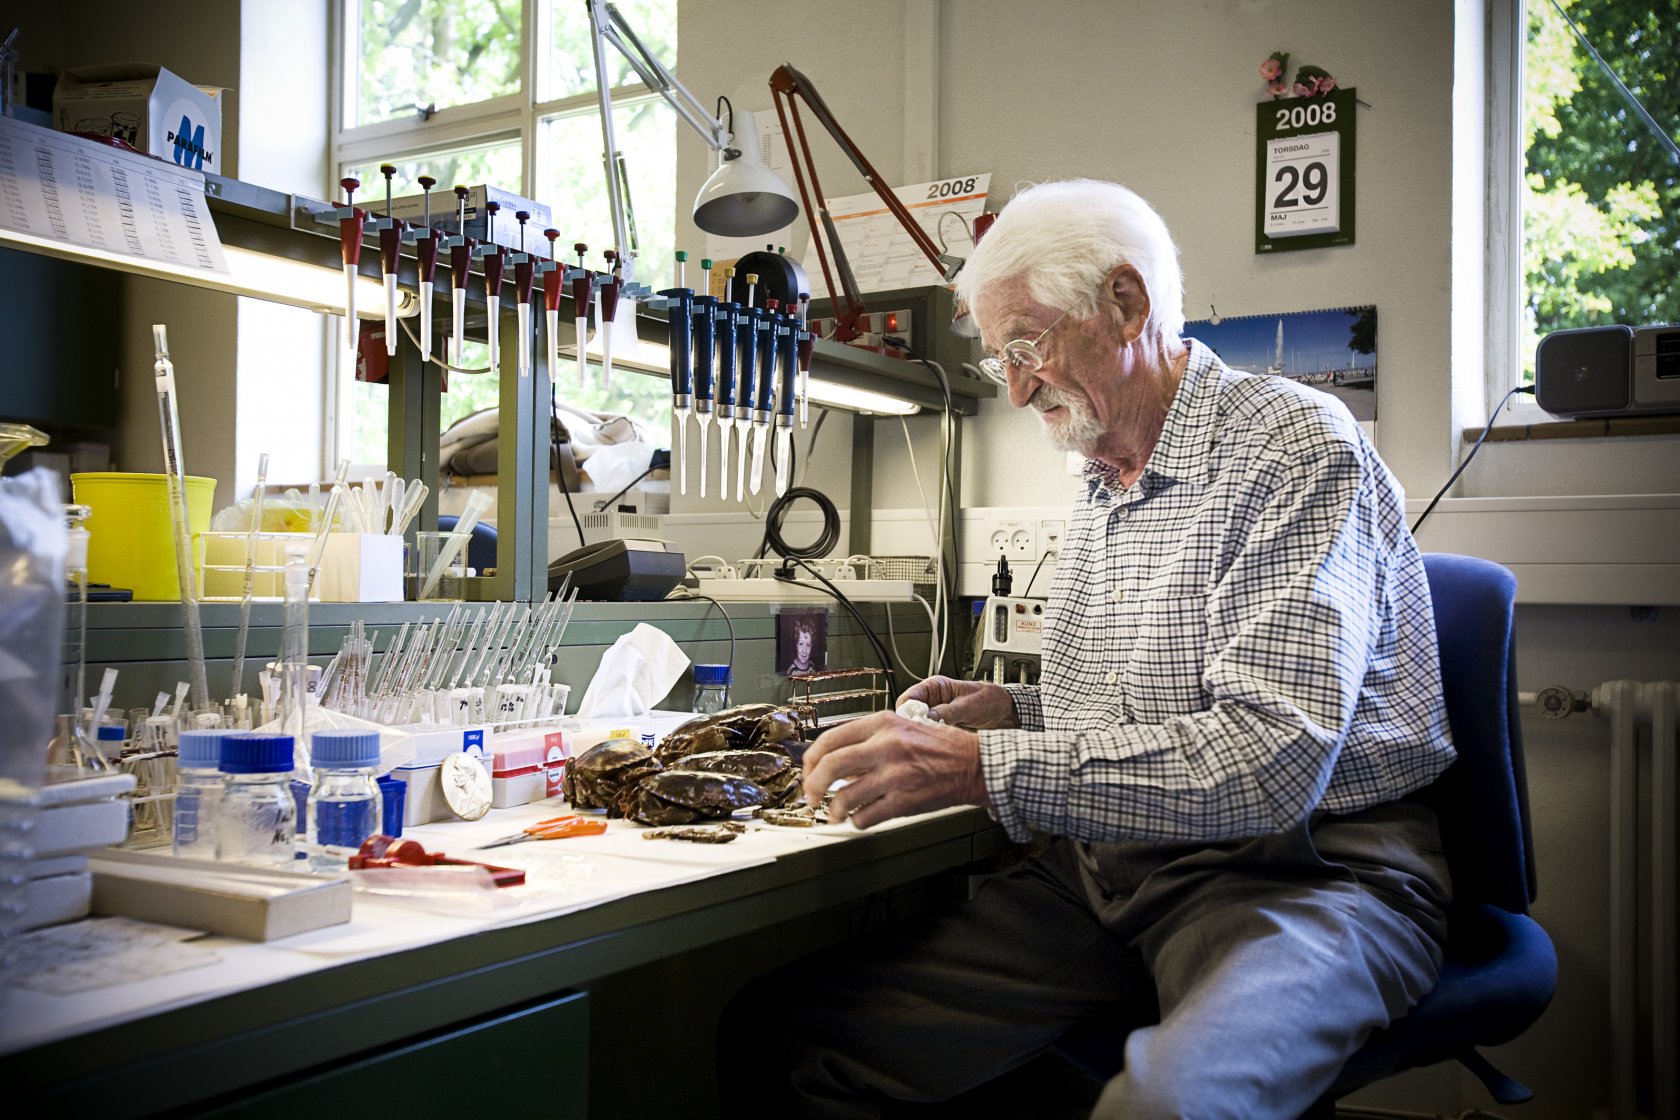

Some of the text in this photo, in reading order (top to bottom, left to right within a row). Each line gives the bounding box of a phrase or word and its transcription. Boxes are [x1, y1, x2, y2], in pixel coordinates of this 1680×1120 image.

[1276, 102, 1337, 131] 2008
[166, 130, 212, 164] PARAFILM
[1273, 143, 1310, 154] TORSDAG
[926, 178, 976, 200] 2008
[1273, 161, 1329, 209] 29
[1270, 213, 1287, 222] MAJ
